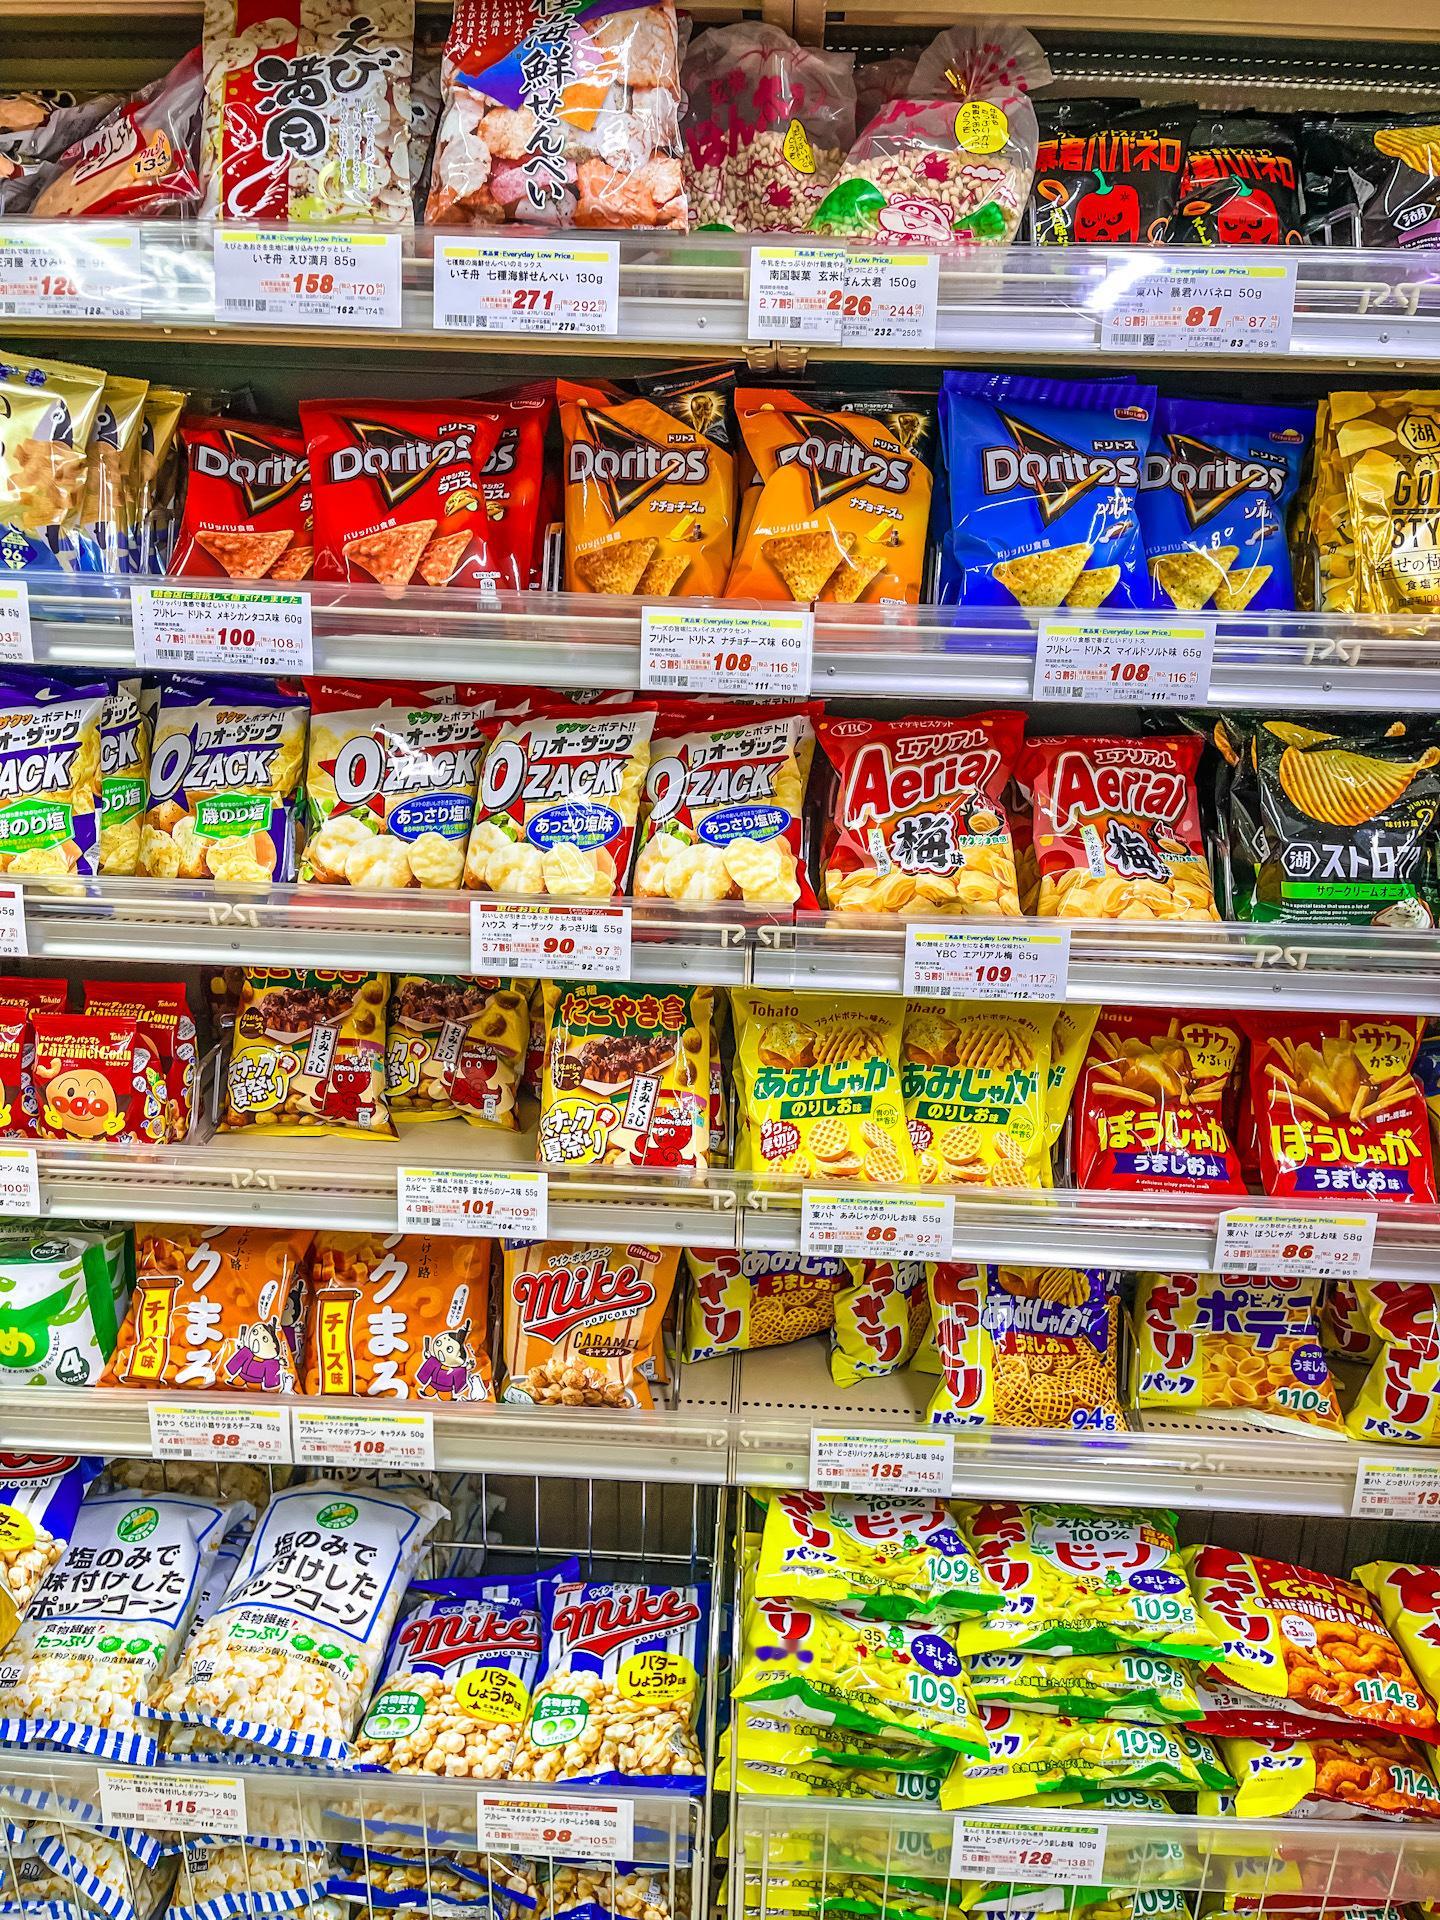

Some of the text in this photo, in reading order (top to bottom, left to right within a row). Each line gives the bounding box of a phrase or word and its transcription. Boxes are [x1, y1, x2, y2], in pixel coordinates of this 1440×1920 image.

[289, 255, 328, 266] えび満月
[334, 256, 356, 266] 85g
[293, 274, 333, 293] 158
[487, 271, 569, 281] 七種海鮮せんべい
[576, 274, 603, 284] 130g
[890, 278, 917, 288] 150g
[512, 290, 553, 310] 271
[1171, 288, 1232, 298] 暴君ハバネロ
[1239, 289, 1262, 299] 50g
[1185, 306, 1223, 327] 81
[438, 423, 477, 436] ドリトス
[668, 433, 695, 443] ドリトス
[873, 438, 900, 453] ドリトス
[1093, 440, 1135, 451] ドリトス
[330, 435, 473, 483] Doritos
[569, 440, 710, 486] Doritos
[776, 436, 913, 494] Doritos
[1250, 449, 1287, 465] ドリトス
[982, 446, 1141, 495] Doritos
[1140, 454, 1288, 496] Doritos
[188, 610, 212, 619] ドリトス
[217, 612, 280, 622] メキシカンタコス味
[284, 615, 302, 624] 60g
[218, 628, 255, 646] 100
[650, 635, 800, 648] フリトレー ドリトス ナチョチーズ味 60g
[1046, 646, 1202, 658] フリトレー ドリトス マイルドソルト味 65g
[714, 653, 752, 671] 108
[1110, 663, 1150, 682] 108
[837, 723, 864, 734] YBC
[896, 729, 989, 763] エアリアル
[1095, 748, 1176, 768] エアリアル
[844, 742, 1000, 830] Aerial
[1053, 751, 1186, 831] Aerial
[201, 804, 265, 826] 磯のり塩
[705, 810, 783, 835] あっさり塩味
[899, 814, 949, 869] 梅
[1111, 823, 1157, 875] 梅
[1289, 850, 1311, 870] 湖
[482, 921, 506, 929] ハウス
[560, 924, 598, 933] あっさり塩
[603, 925, 622, 934] 55g
[543, 938, 575, 954] 90
[936, 950, 1038, 961] YBC エアリアル梅 65g
[975, 966, 1012, 982] 109
[561, 993, 687, 1030] たこやき亭
[750, 1001, 799, 1017] Tohato
[792, 1098, 863, 1116] のりしお味
[927, 1102, 1000, 1124] のりしお味
[1271, 1124, 1423, 1166] ぼうじゃが
[1313, 1167, 1400, 1192] うましお味
[430, 1185, 468, 1194] 元祖たこやき亭
[525, 1189, 538, 1197] 55g
[462, 1200, 494, 1214] 101
[840, 1212, 916, 1222] あみじゃがのりしお味
[922, 1215, 941, 1223] 55g
[866, 1226, 897, 1241] 86
[1255, 1230, 1293, 1238] ぼうじゃが
[1282, 1244, 1314, 1259] 86
[325, 1312, 344, 1386] チーズ味
[573, 1332, 639, 1350] CARAMEL
[585, 1348, 625, 1356] キャラメル
[1142, 1373, 1195, 1395] パック
[1277, 1387, 1330, 1414] 110g
[1071, 1408, 1116, 1431] 94g
[211, 1433, 240, 1446] 88
[353, 1440, 384, 1454] 108
[871, 1464, 903, 1478] 135
[1068, 1528, 1130, 1542] 100%
[65, 1545, 182, 1569] 塩のみで
[274, 1530, 378, 1566] 塩のみで
[785, 1547, 837, 1562] パック
[1055, 1542, 1150, 1572] ビーノ
[928, 1558, 980, 1584] 109g
[41, 1570, 186, 1595] 味付けした
[1132, 1576, 1181, 1585] うましお
[27, 1594, 178, 1621] ポップコーン
[1131, 1597, 1194, 1622] 109g
[228, 1622, 289, 1642] たっぷり
[35, 1635, 95, 1649] たっぷり
[1224, 1642, 1275, 1665] パック
[640, 1656, 678, 1670] バター
[481, 1670, 517, 1688] バター
[629, 1671, 687, 1688] しょうゆ味
[1122, 1657, 1183, 1689] 109g
[907, 1673, 967, 1714] 109g
[1357, 1680, 1418, 1710] 114g
[1116, 1727, 1180, 1760] 109g
[1249, 1756, 1305, 1772] パック
[164, 1800, 197, 1813] 115
[543, 1829, 572, 1842] 98
[1079, 1841, 1097, 1849] 109g
[1019, 1851, 1052, 1865] 128
